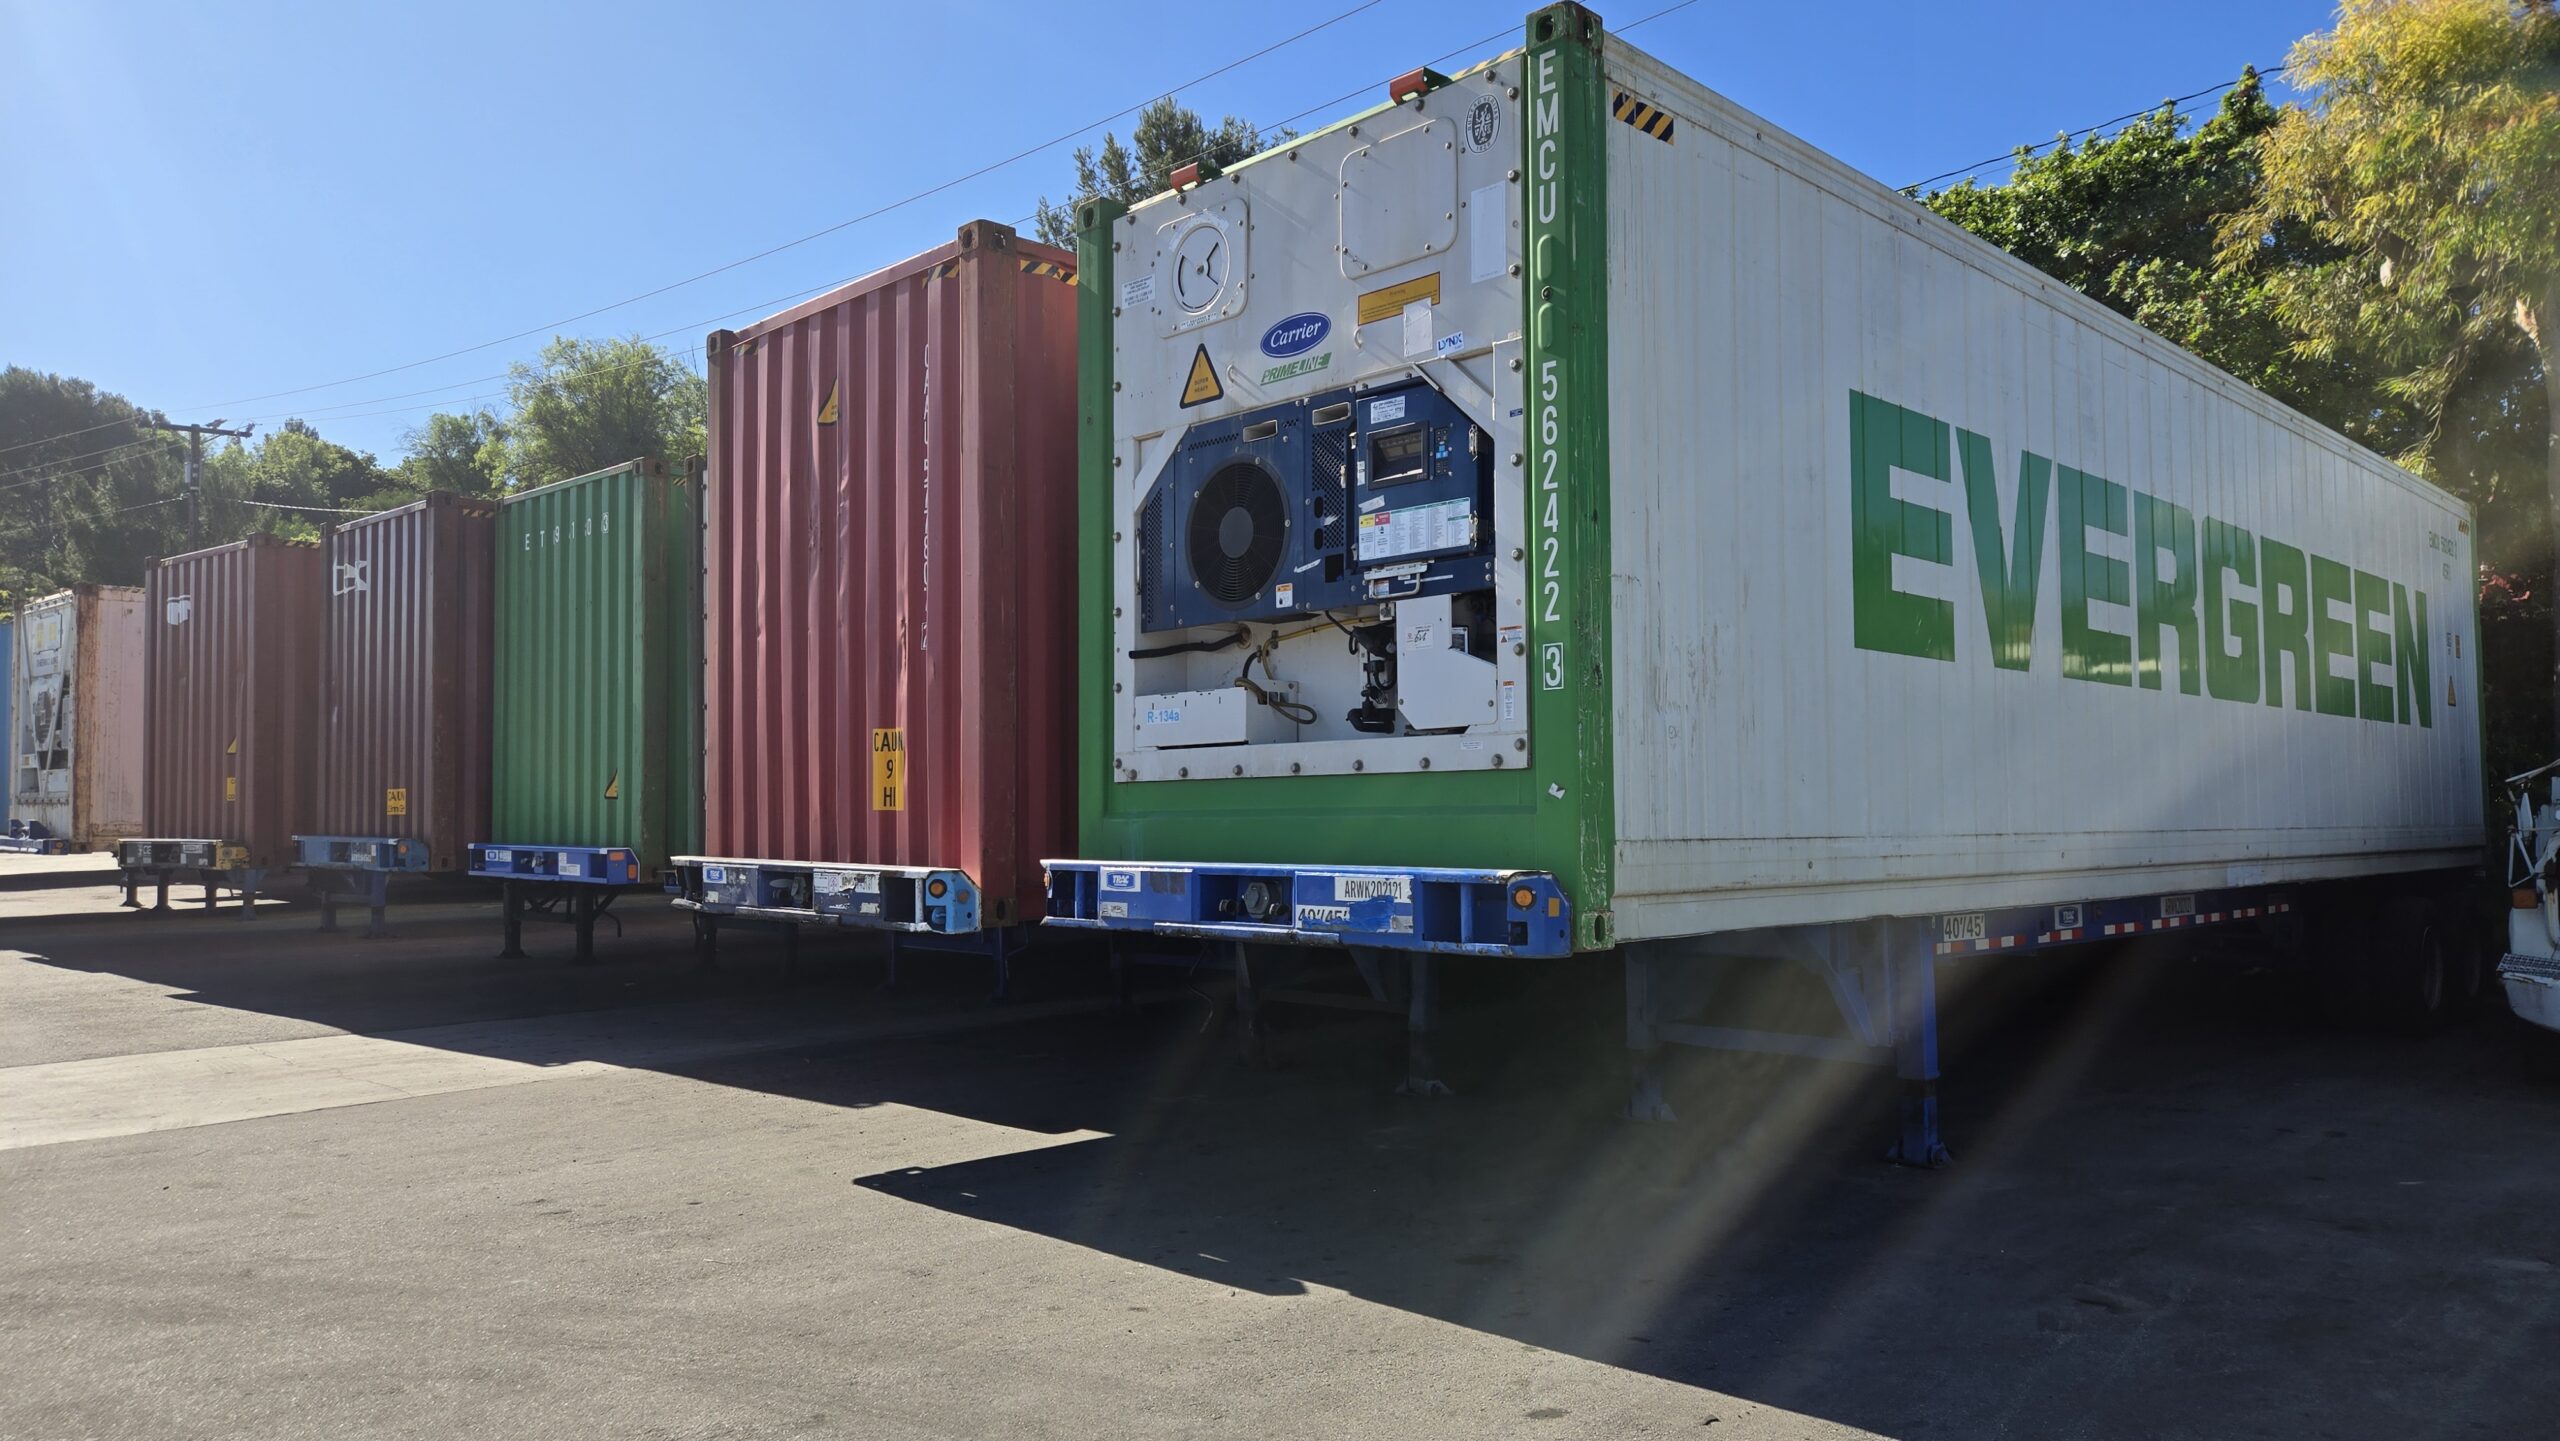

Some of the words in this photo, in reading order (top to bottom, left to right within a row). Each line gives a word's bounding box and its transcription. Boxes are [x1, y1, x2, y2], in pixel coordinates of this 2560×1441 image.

[1536, 49, 1559, 224] EMCU
[1270, 321, 1322, 348] Carrier
[1438, 333, 1463, 351] LYNX
[1542, 360, 1561, 622] 562422
[1849, 388, 2432, 728] EVERGREEN
[1147, 709, 1180, 723] R-134a
[1944, 914, 1985, 940] 40'/45'
